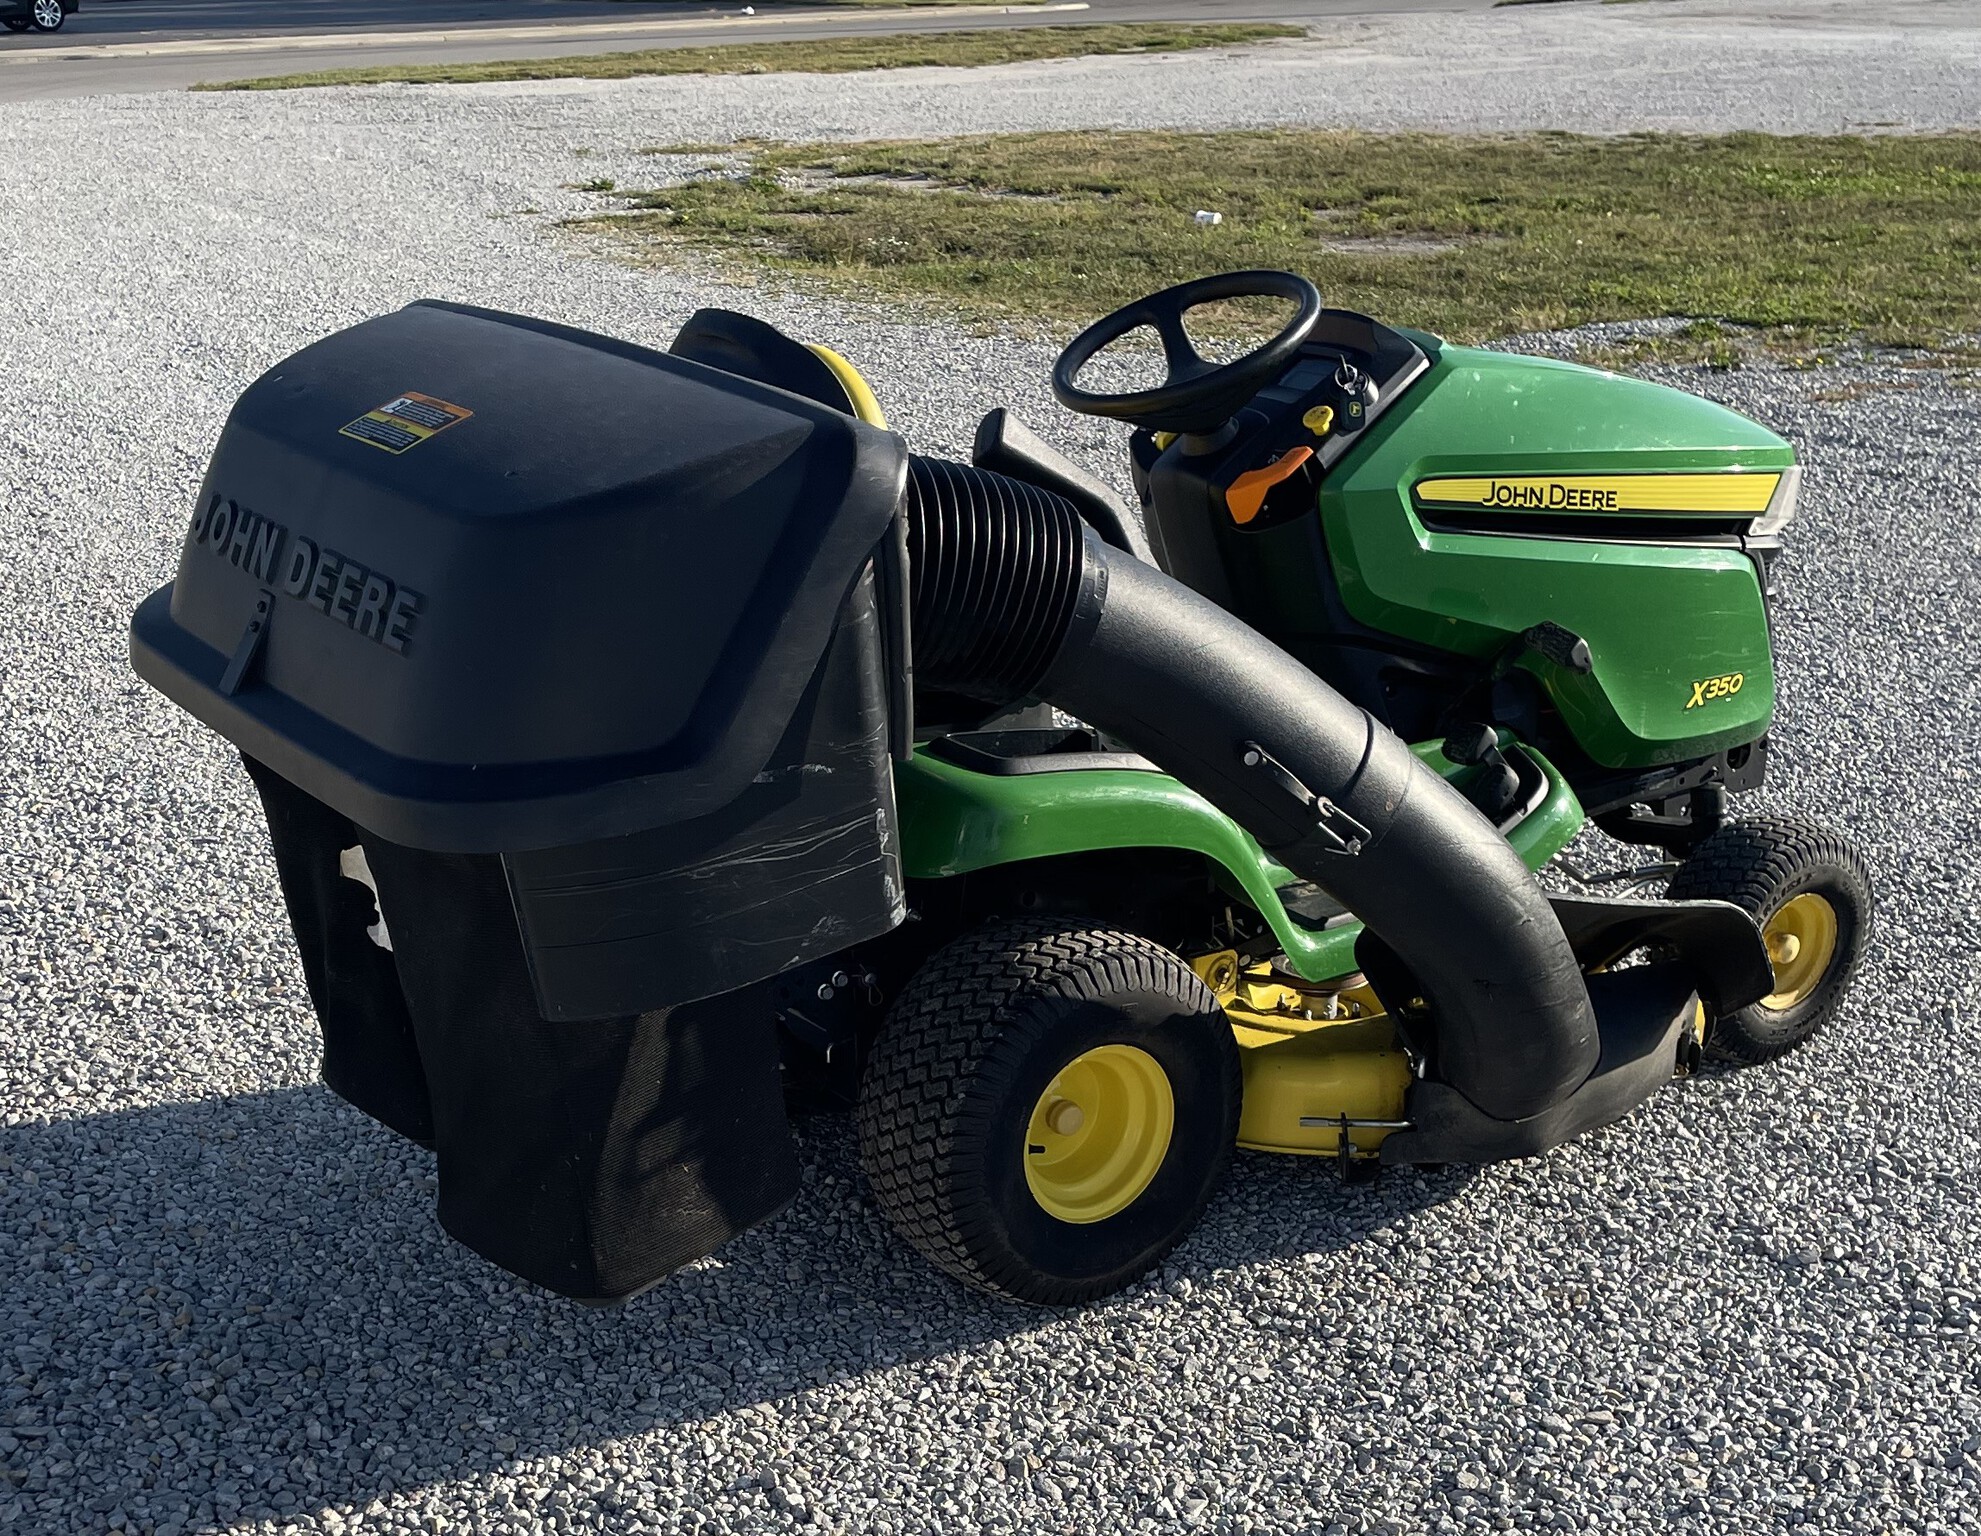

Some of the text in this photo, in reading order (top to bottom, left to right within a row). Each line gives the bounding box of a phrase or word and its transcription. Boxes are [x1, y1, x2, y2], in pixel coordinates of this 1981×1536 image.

[1482, 480, 1618, 509] JOHN DEERE
[194, 492, 424, 655] JOHN DEERE
[1685, 672, 1744, 709] X350
